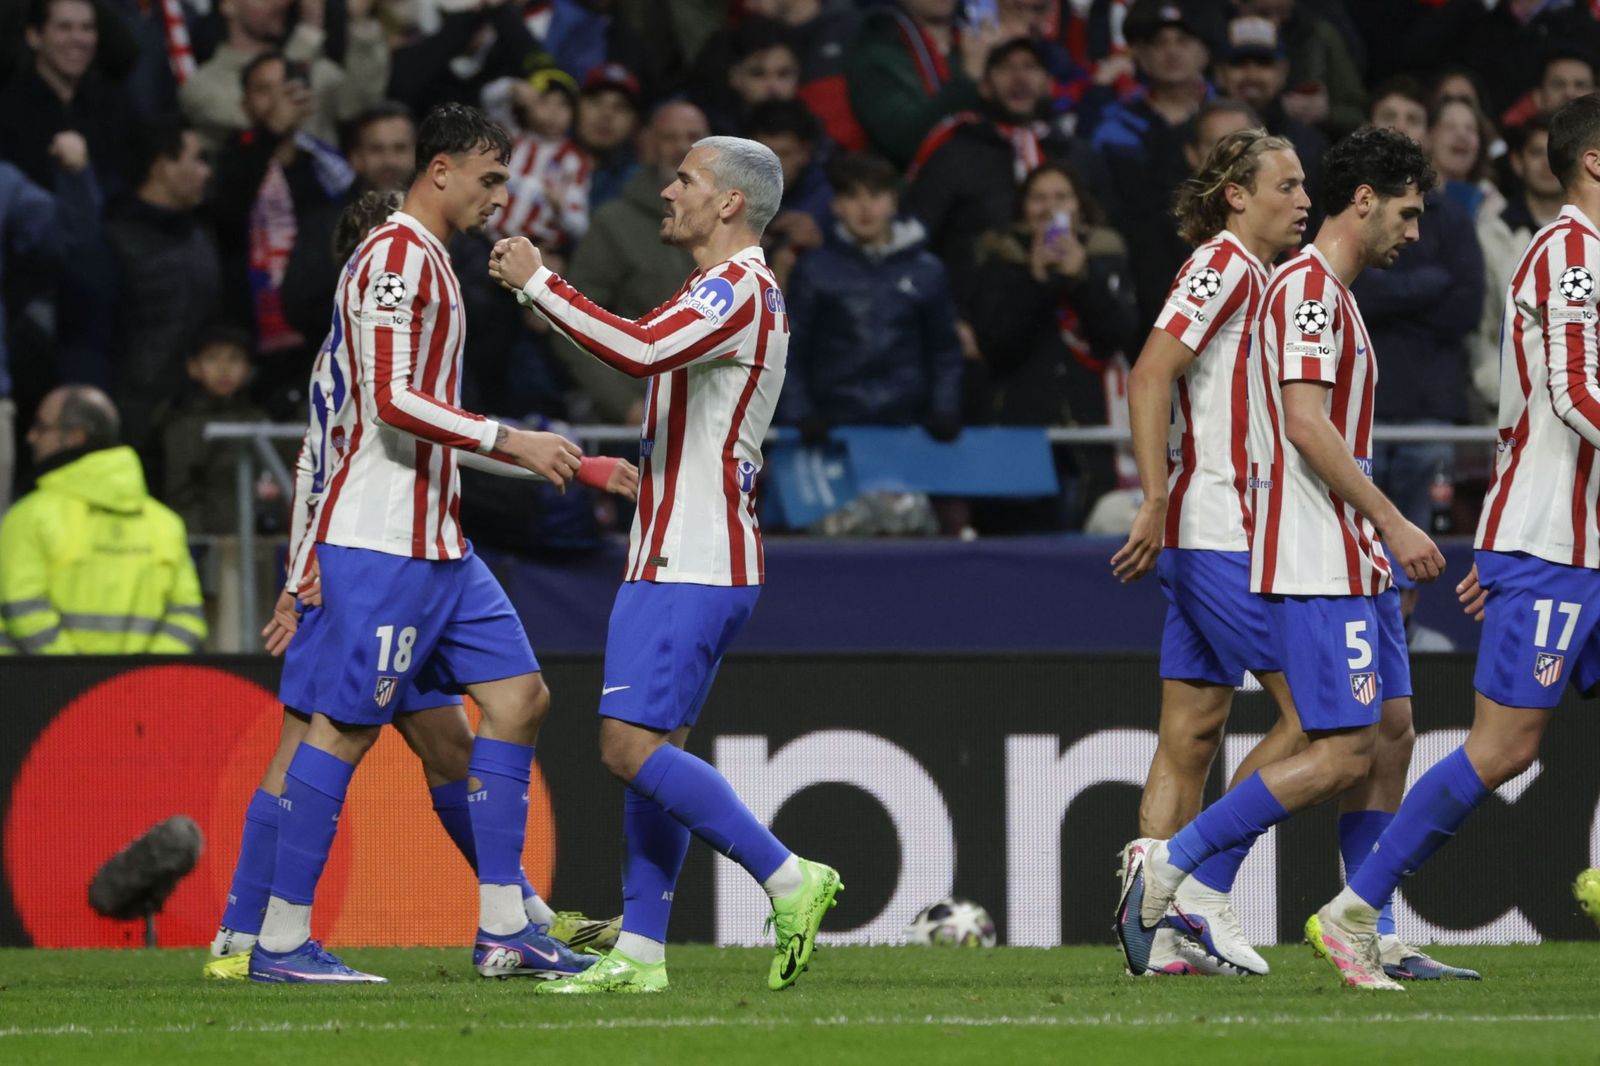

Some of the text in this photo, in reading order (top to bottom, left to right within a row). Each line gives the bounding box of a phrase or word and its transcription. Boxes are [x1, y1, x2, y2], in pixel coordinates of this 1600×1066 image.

[376, 625, 417, 673] 18
[1345, 620, 1372, 669] 5
[1533, 599, 1582, 650] 17
